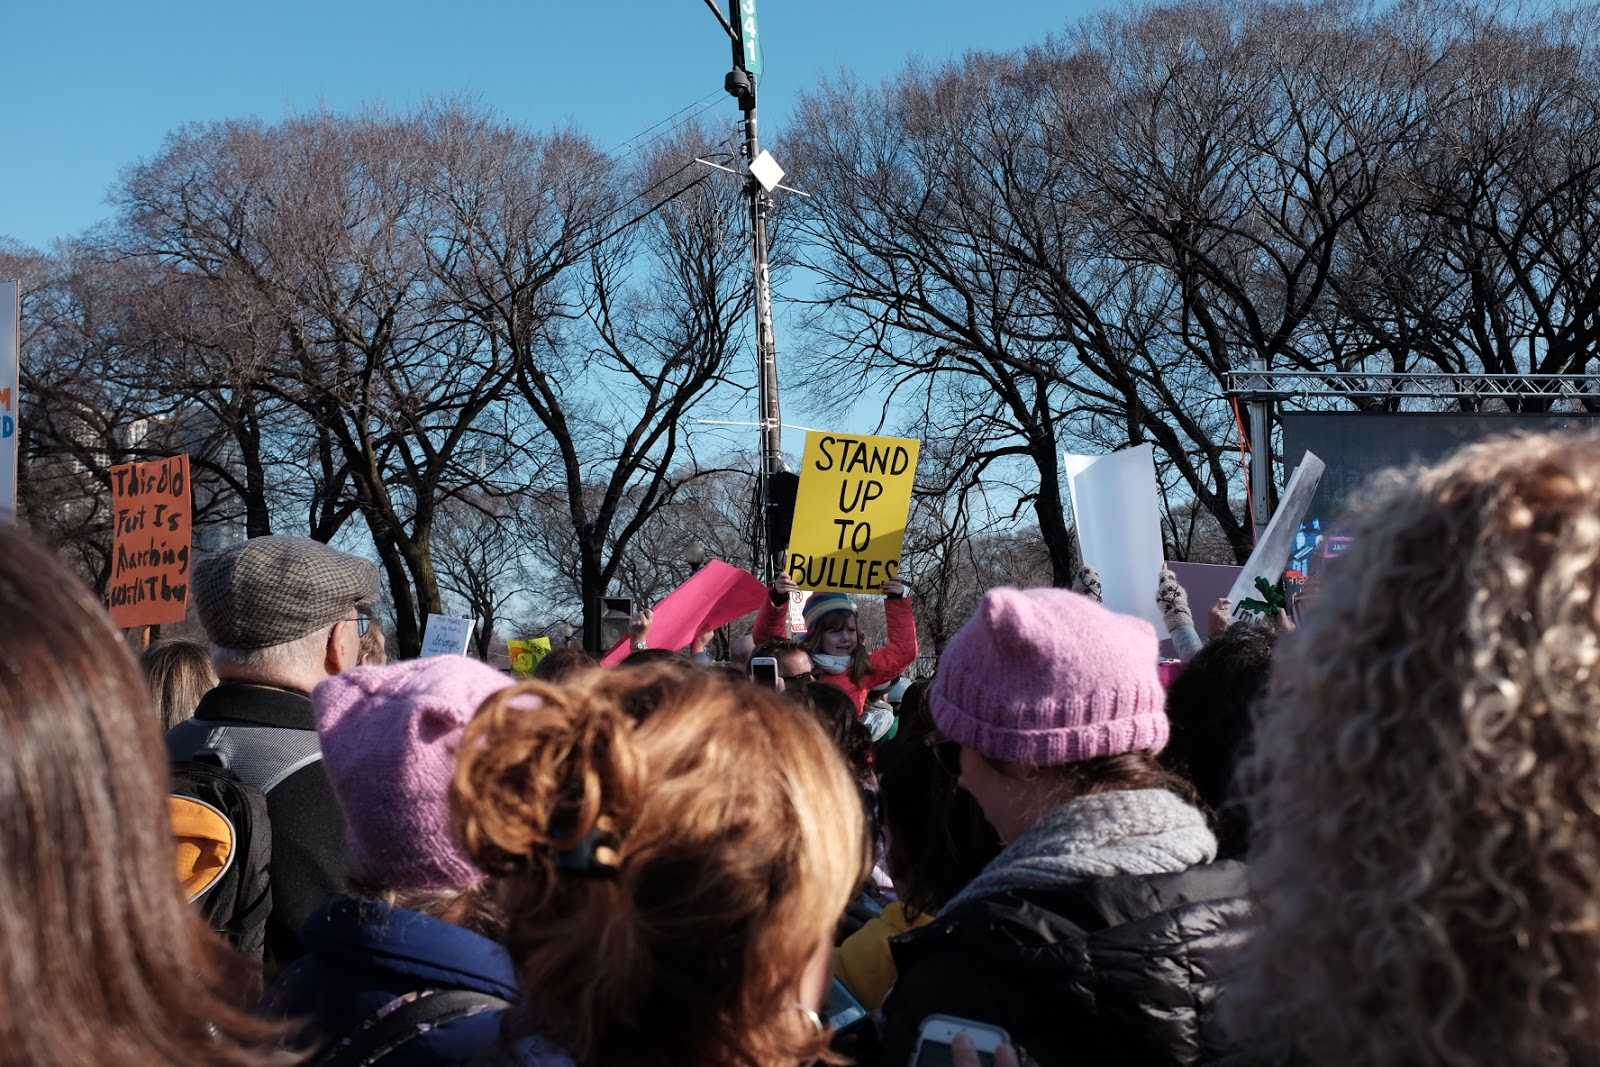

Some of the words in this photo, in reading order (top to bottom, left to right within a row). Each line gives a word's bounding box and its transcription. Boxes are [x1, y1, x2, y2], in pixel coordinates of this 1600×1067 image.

[815, 436, 909, 475] STAND
[113, 465, 156, 497] This
[839, 479, 884, 513] UP
[152, 504, 182, 532] Is
[833, 518, 871, 553] TO
[789, 553, 898, 590] BULLIES
